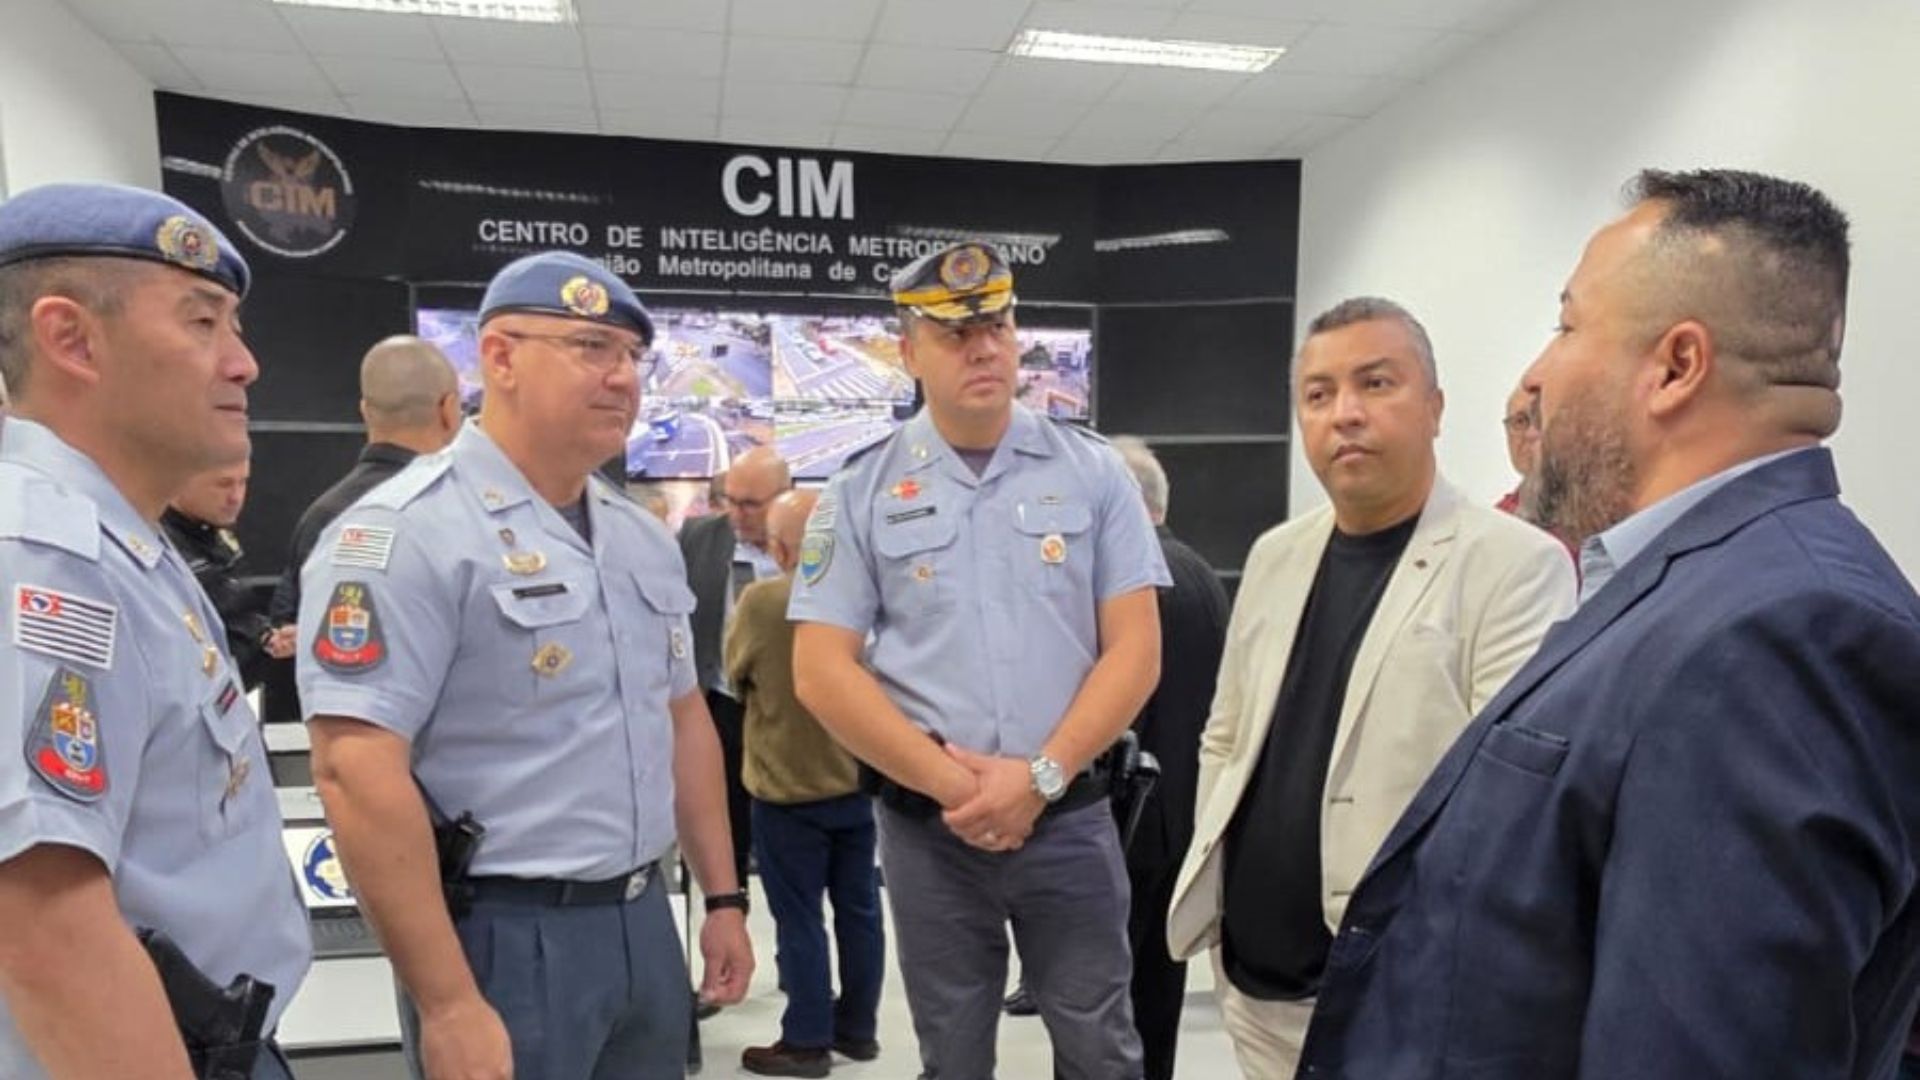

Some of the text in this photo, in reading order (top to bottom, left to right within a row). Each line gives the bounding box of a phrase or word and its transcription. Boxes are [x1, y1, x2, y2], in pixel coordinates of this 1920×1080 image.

[248, 181, 336, 220] CIM
[722, 154, 855, 220] CIM
[478, 219, 590, 246] CENTRO
[606, 225, 644, 249] DE
[660, 227, 834, 254] INTELIGÊNCIA
[658, 254, 813, 282] Metropolitana
[828, 260, 857, 281] de
